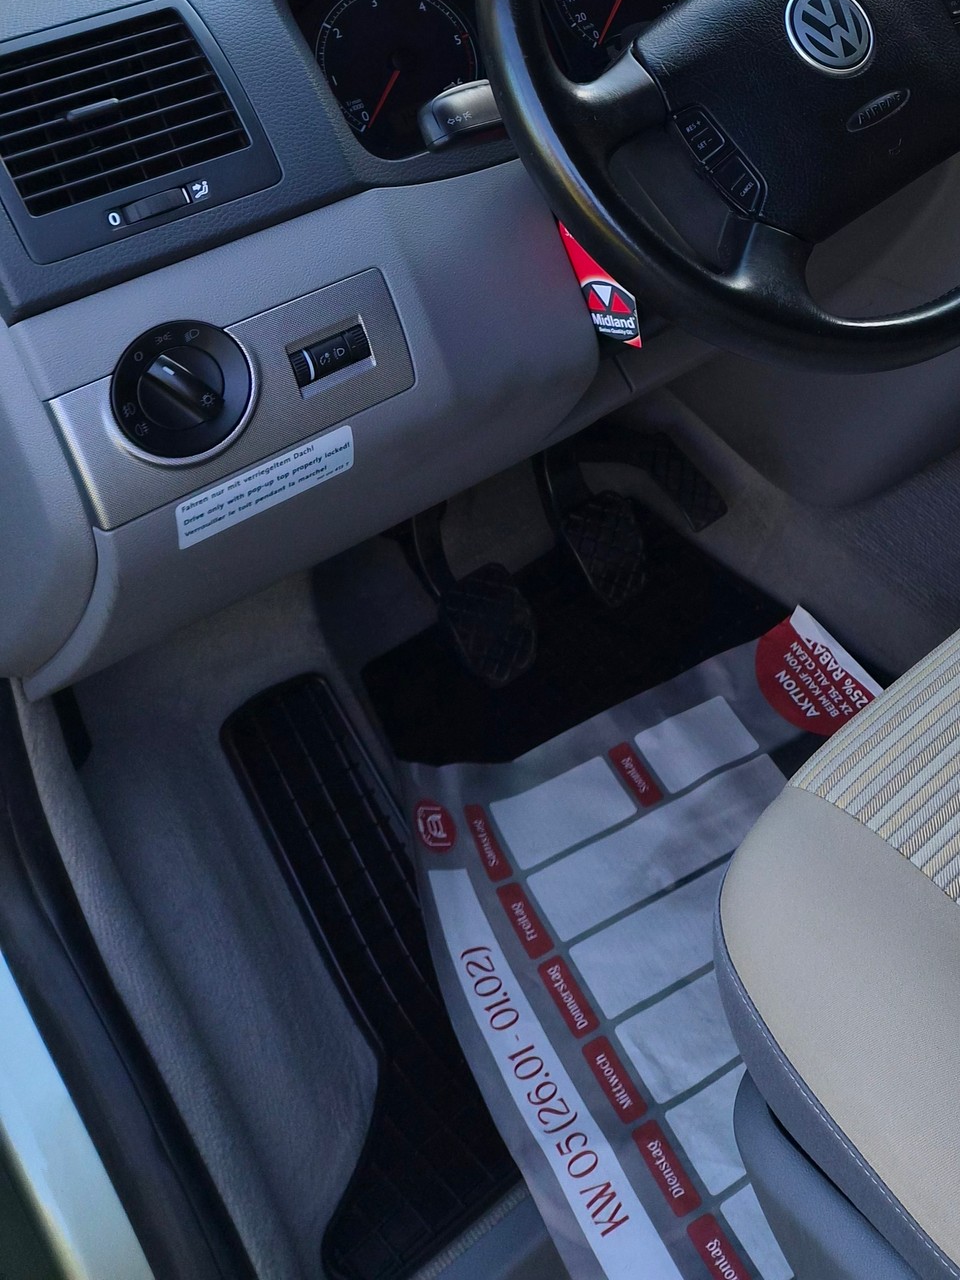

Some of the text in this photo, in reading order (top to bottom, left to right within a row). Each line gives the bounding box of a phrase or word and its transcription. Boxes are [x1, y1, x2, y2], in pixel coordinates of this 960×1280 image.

[419, 2, 427, 11] 4
[575, 12, 587, 22] 20
[333, 28, 342, 38] 2
[454, 35, 461, 45] 5
[592, 30, 600, 39] 0
[361, 111, 370, 121] 0
[591, 313, 635, 329] Midland
[181, 445, 315, 513] Fahren nur mit verriegeltem Dach!
[183, 513, 205, 526] Drive
[207, 503, 225, 515] only
[227, 493, 245, 505] with
[247, 480, 274, 496] pop-up
[276, 472, 290, 482] top
[292, 456, 323, 475] properly
[325, 442, 350, 458] locked!
[238, 502, 253, 511] toit
[255, 485, 286, 504] pendant
[298, 465, 327, 483] marche!
[774, 669, 821, 718] AKTION
[783, 652, 840, 718] BEIM KAUF VON
[790, 641, 854, 716] 2X 25L ALL CLEAN
[804, 637, 869, 709] 25% RABAT
[473, 819, 499, 867] Samstag
[511, 901, 538, 942] Freitag
[461, 946, 520, 1031] 01.02)
[547, 964, 590, 1030] Donnerstag
[595, 1053, 633, 1110] Mittwoch
[646, 1140, 685, 1199] Dienstag
[579, 1181, 629, 1238] KW
[705, 1238, 740, 1280] ontag
